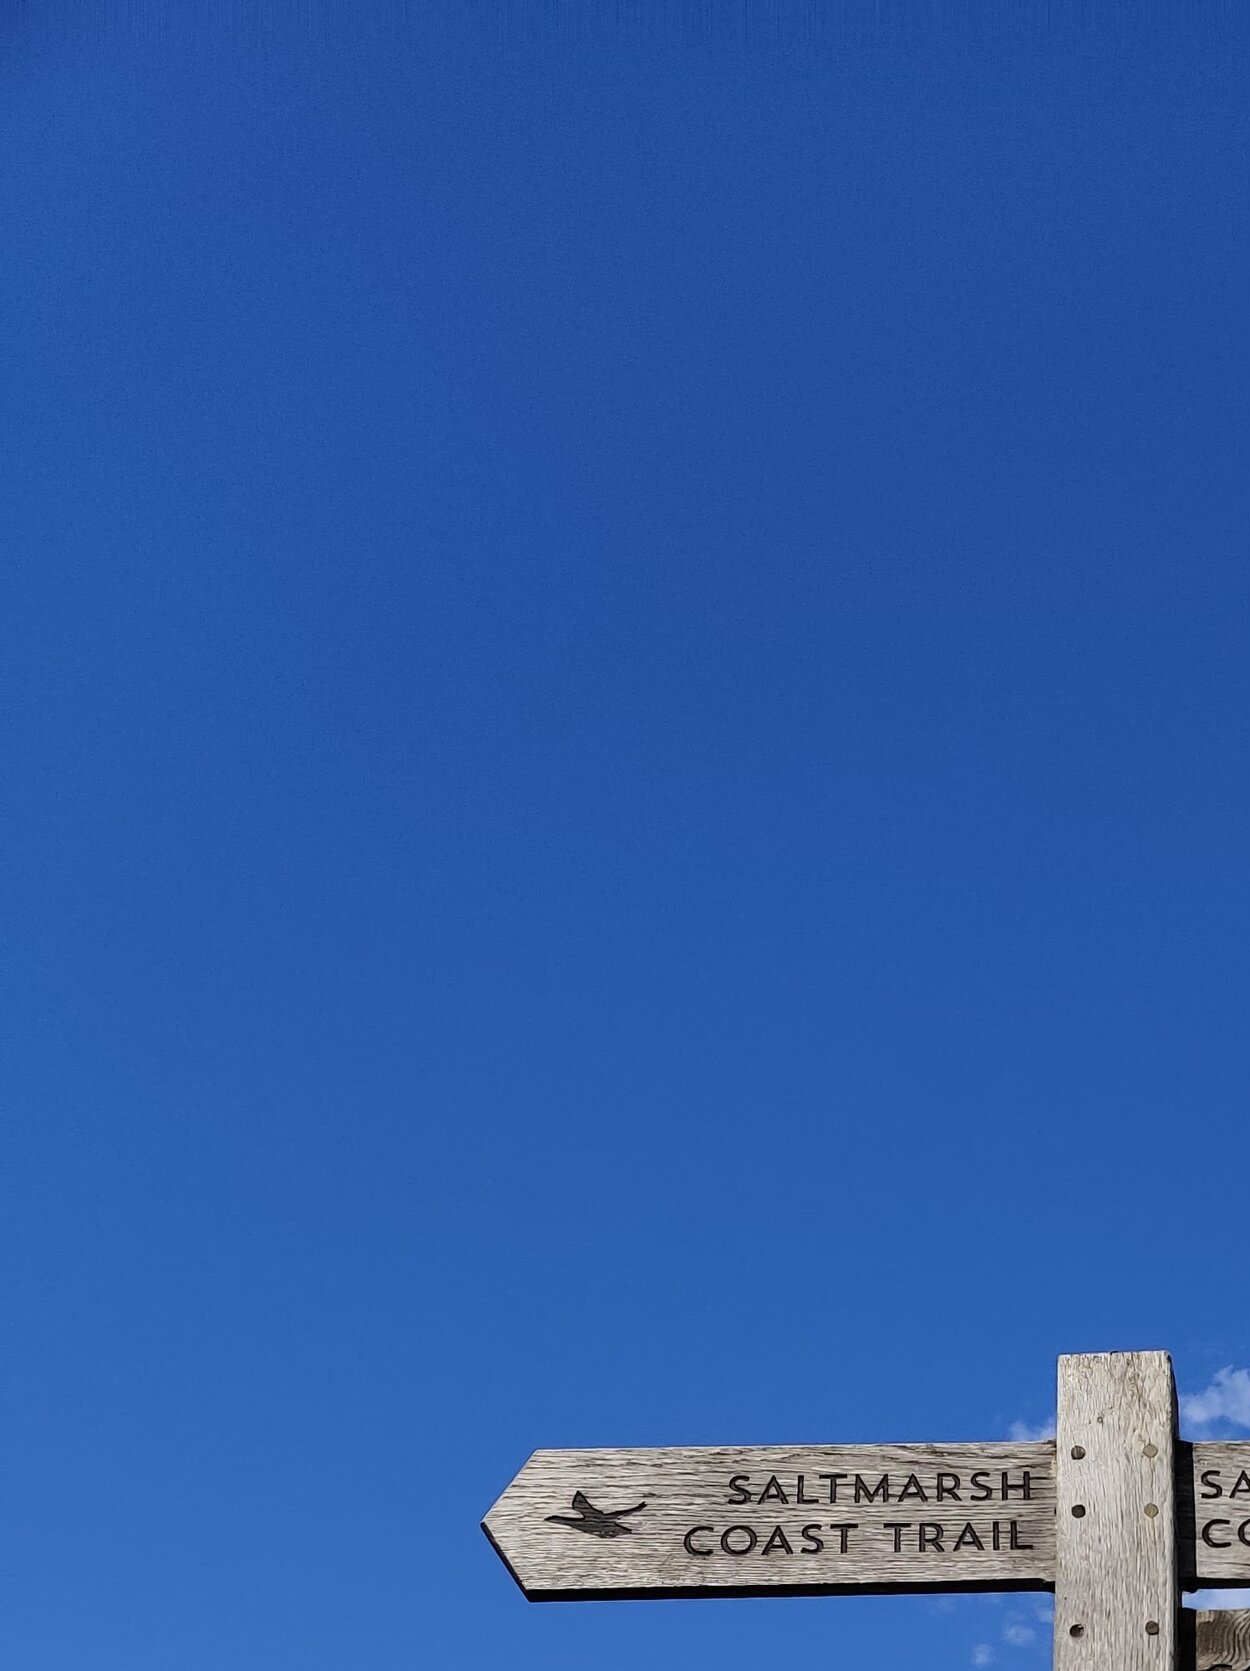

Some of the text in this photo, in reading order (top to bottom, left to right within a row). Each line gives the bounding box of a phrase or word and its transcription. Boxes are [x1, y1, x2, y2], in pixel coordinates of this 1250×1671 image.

[727, 1471, 1034, 1506] SALTMARSH
[683, 1521, 1034, 1557] COAST TRAIL
